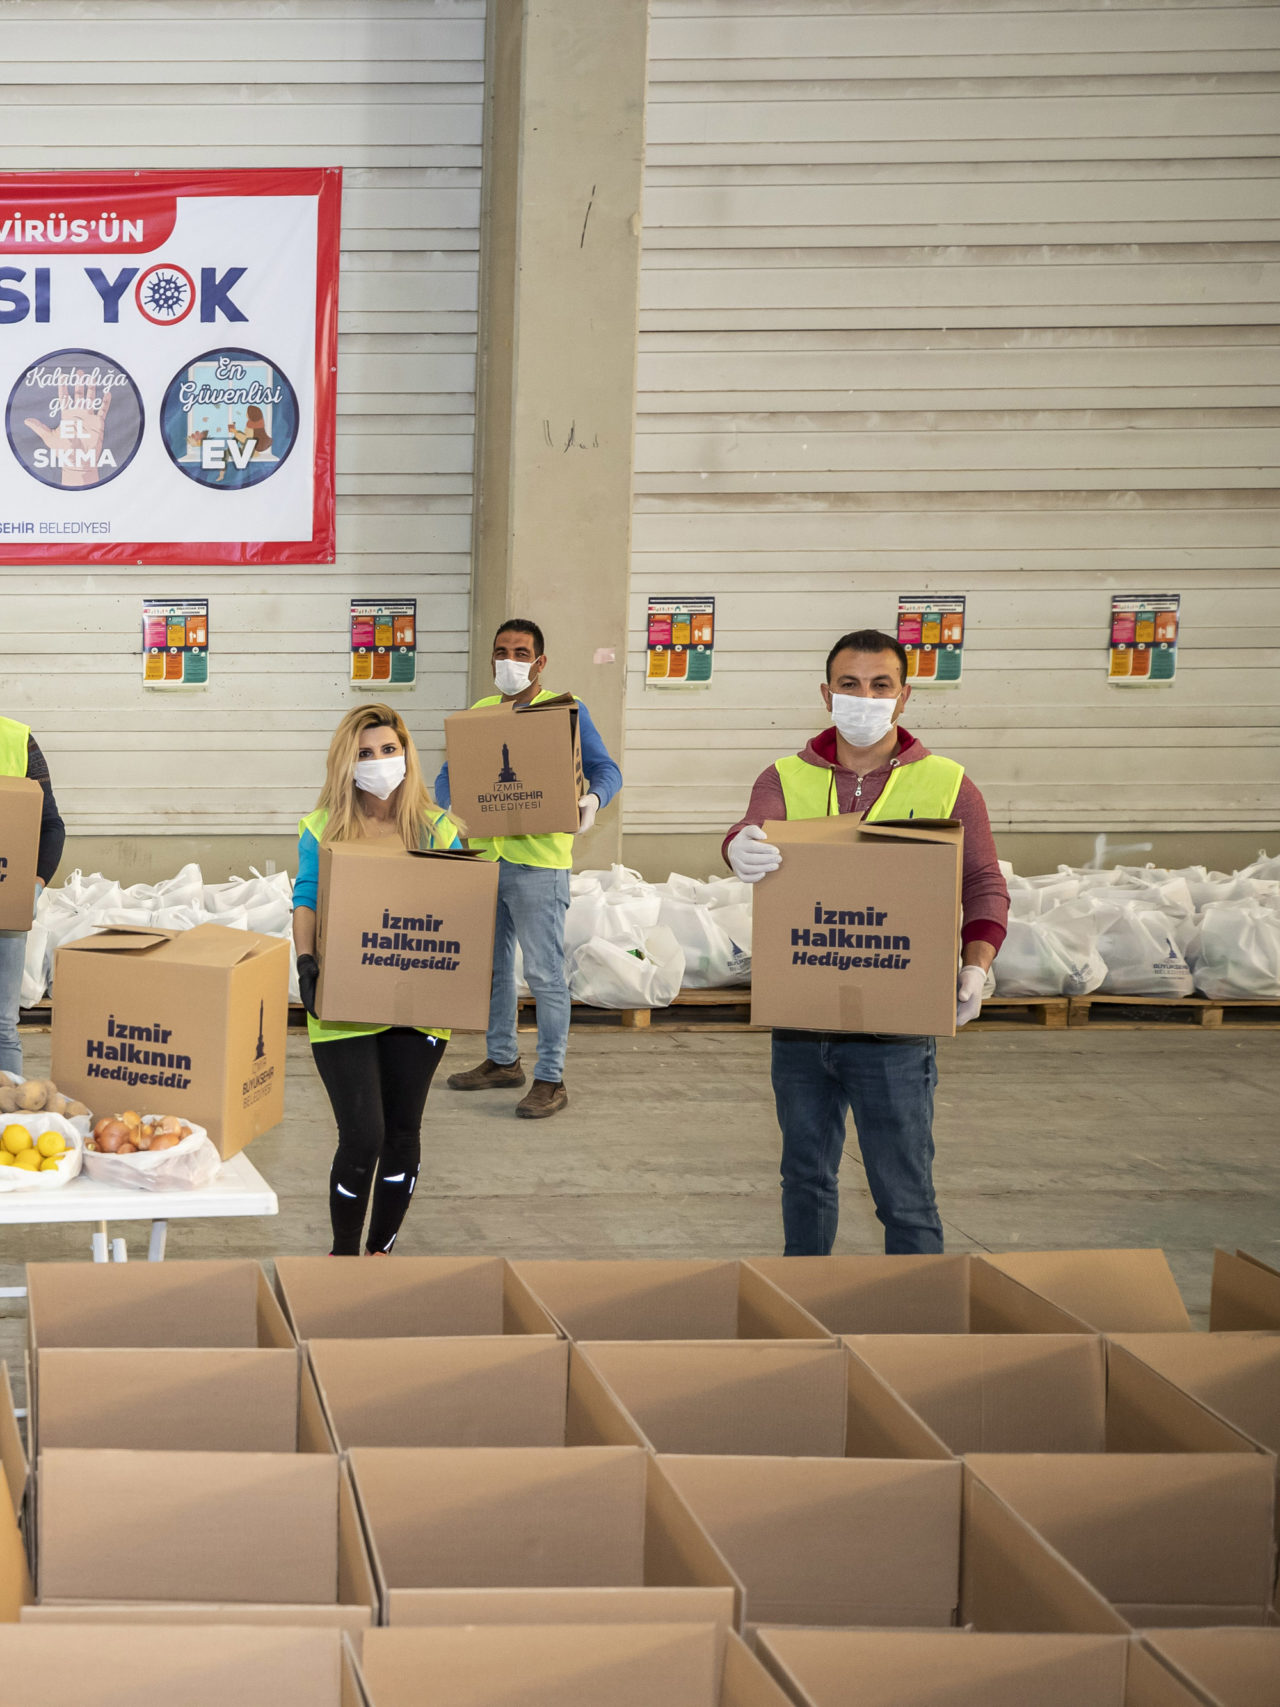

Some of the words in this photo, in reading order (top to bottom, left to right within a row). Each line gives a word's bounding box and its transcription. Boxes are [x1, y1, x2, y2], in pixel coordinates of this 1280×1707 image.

[85, 263, 249, 326] YOK
[25, 366, 128, 394] Kalabalığa
[215, 357, 247, 381] En
[48, 395, 103, 418] girme
[178, 381, 284, 411] Güvenlisi
[59, 419, 91, 439] EL
[33, 448, 118, 469] SIKMA
[201, 438, 258, 470] EV
[39, 521, 111, 534] BELEDİYESİ
[382, 908, 443, 932] İzmir
[814, 901, 888, 926] İzmir
[361, 932, 460, 954] Halkının
[791, 928, 910, 950] Halkının
[361, 953, 460, 971] Hediyesidir
[792, 951, 911, 970] Hediyesidir
[107, 1014, 172, 1044] İzmir
[86, 1039, 191, 1070] Halkının
[87, 1063, 191, 1090] Hediyesidir
